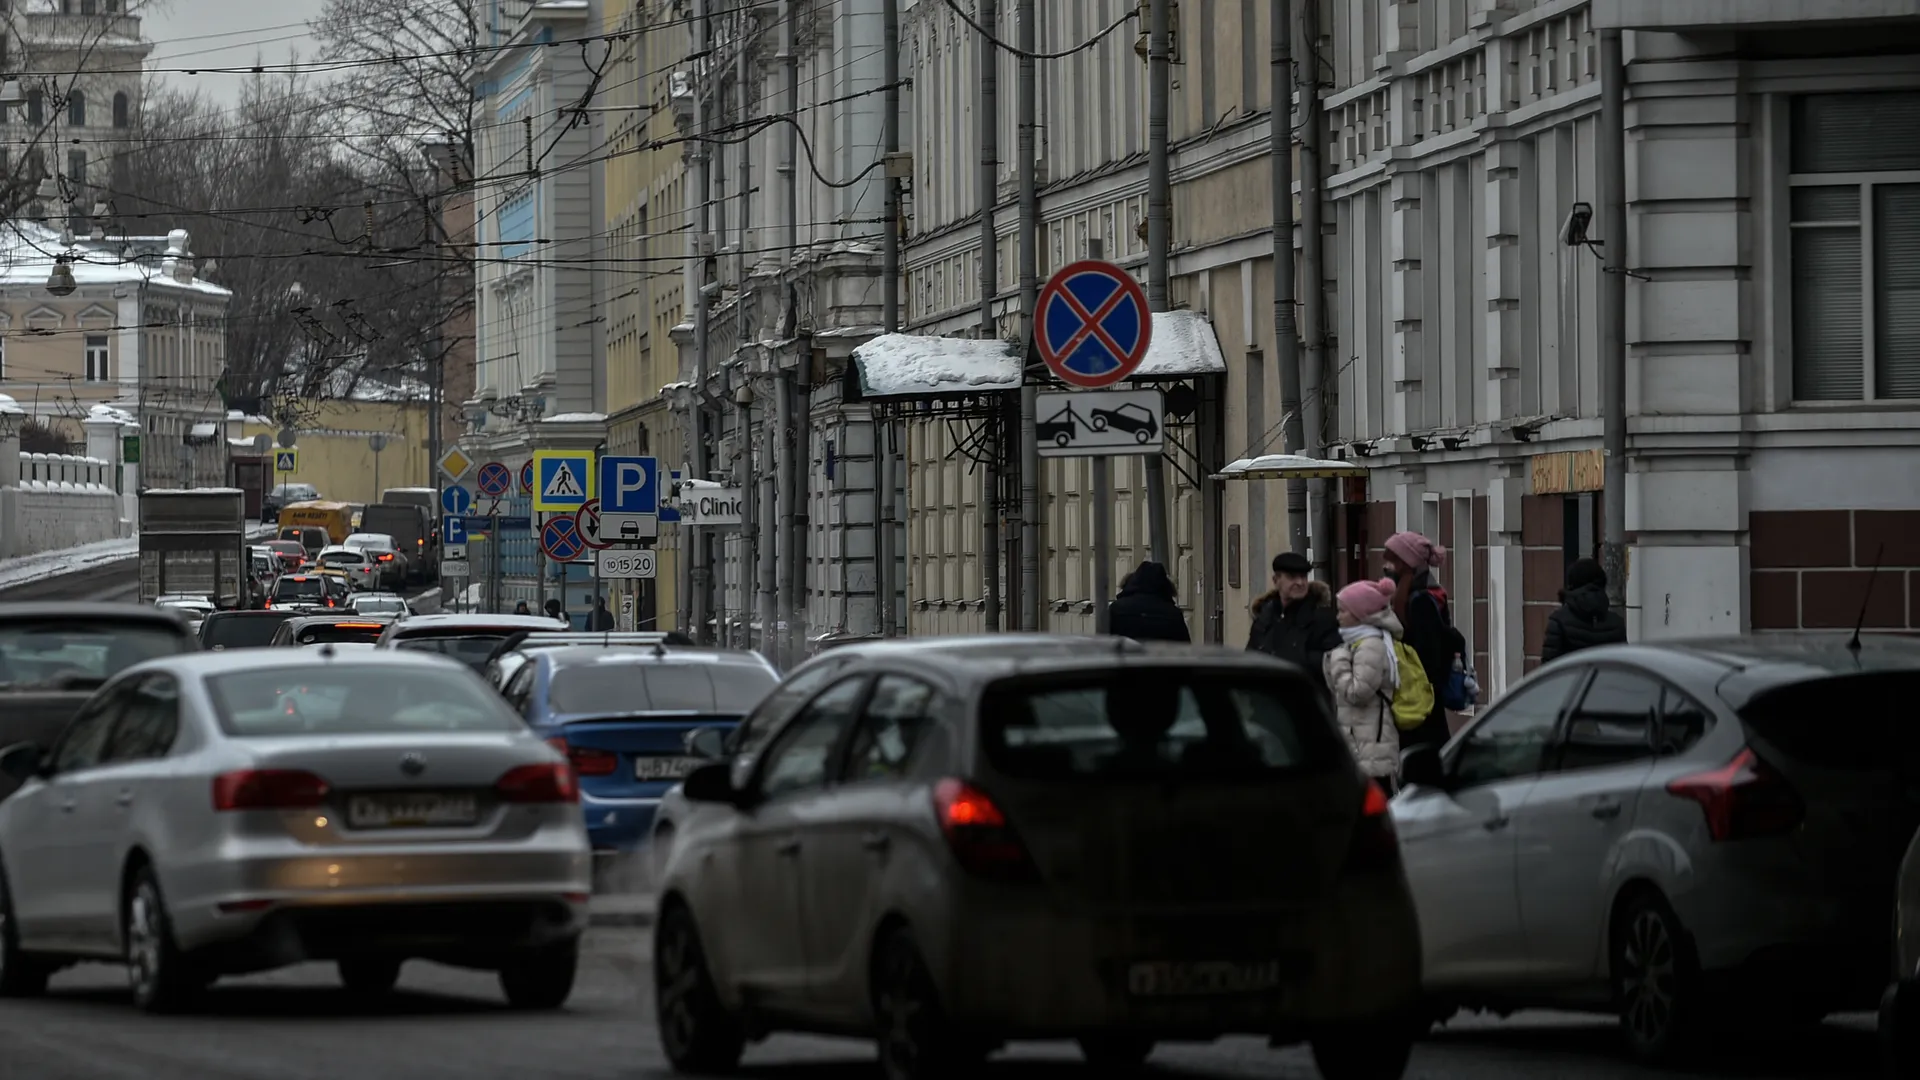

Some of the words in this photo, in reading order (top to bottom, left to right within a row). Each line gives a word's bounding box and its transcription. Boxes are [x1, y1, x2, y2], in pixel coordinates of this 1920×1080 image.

[616, 462, 647, 507] P
[607, 560, 616, 569] 10
[618, 559, 630, 570] 15
[633, 558, 651, 570] 20
